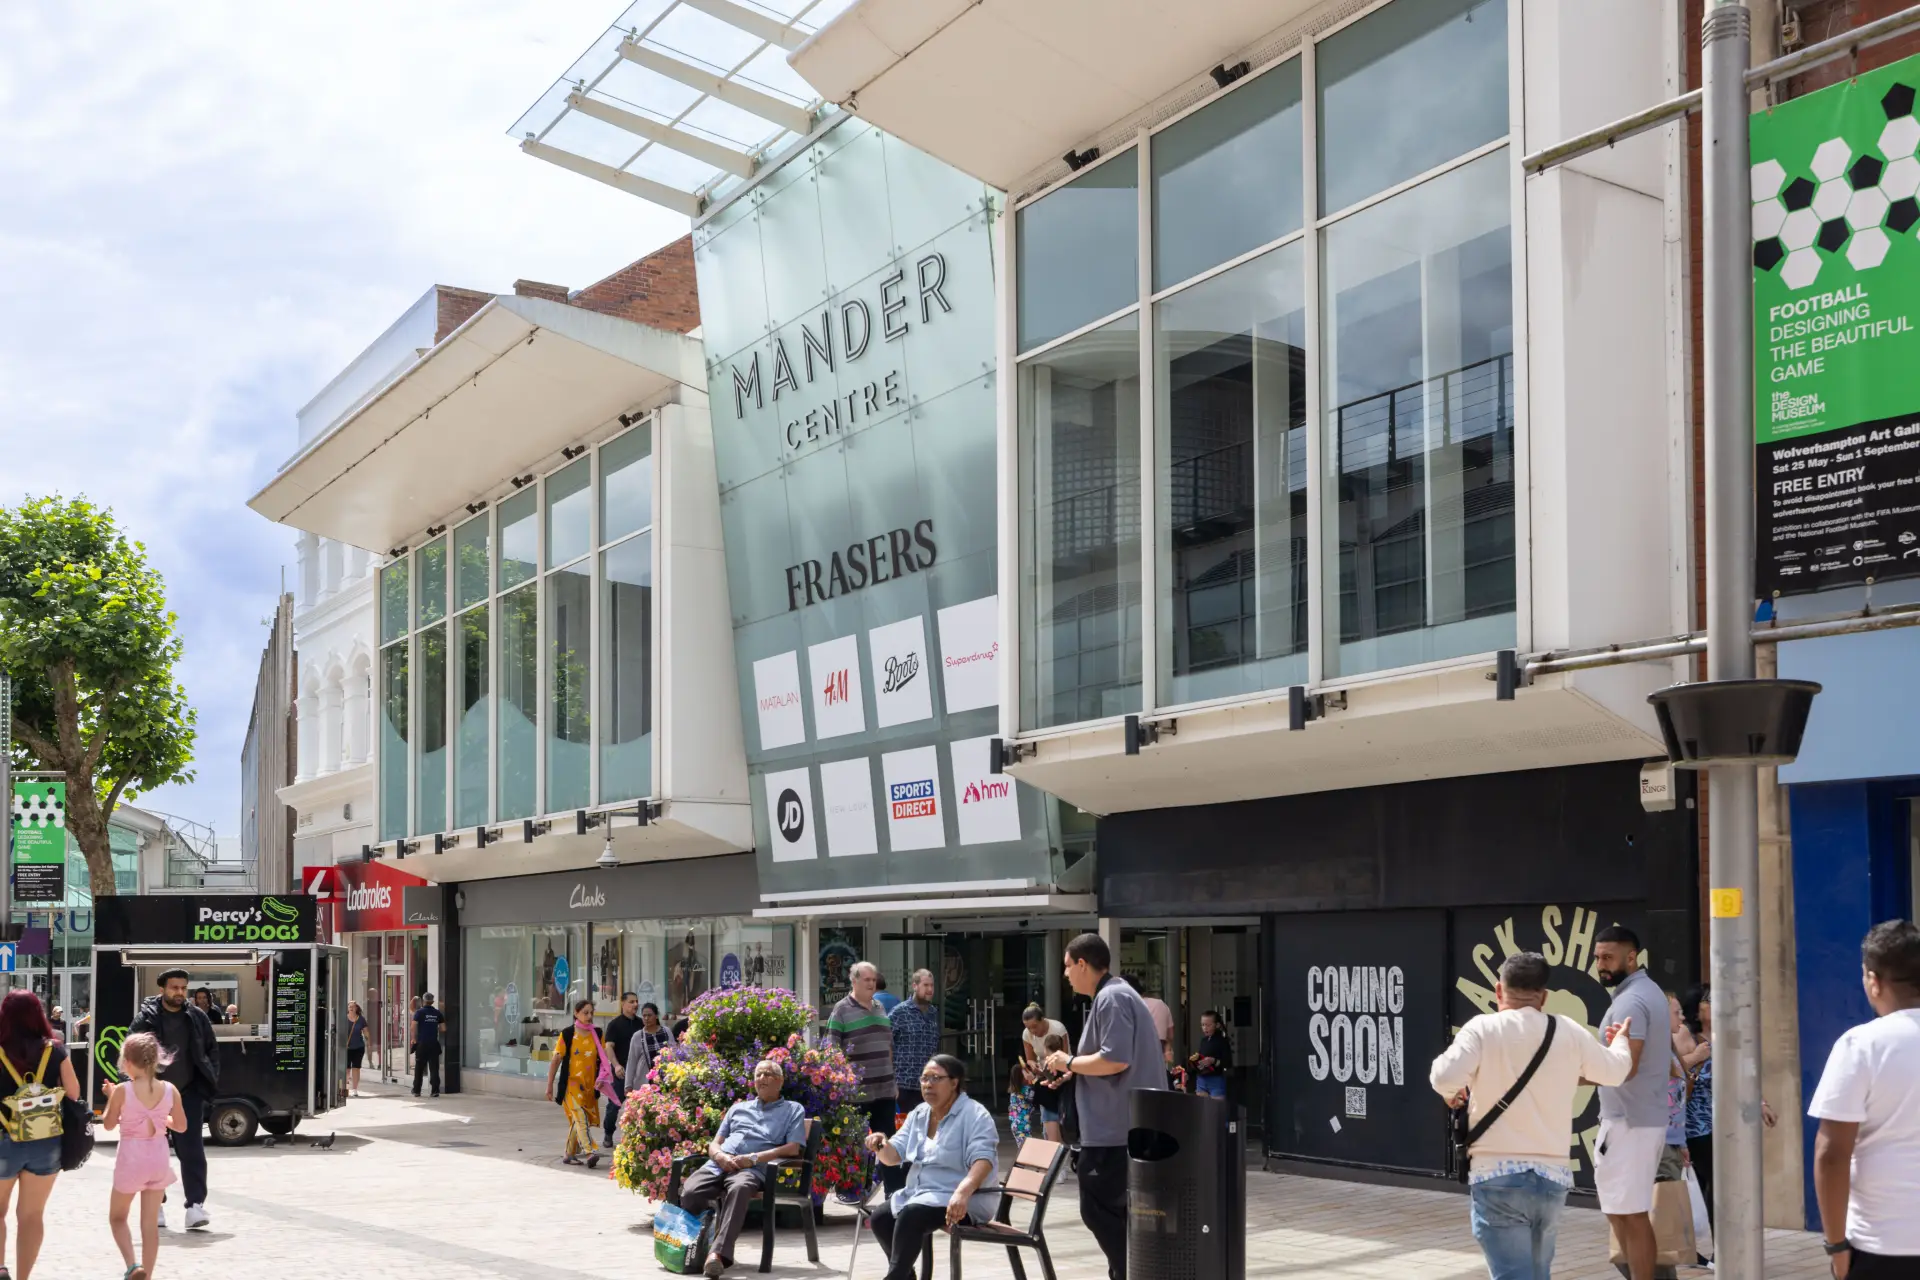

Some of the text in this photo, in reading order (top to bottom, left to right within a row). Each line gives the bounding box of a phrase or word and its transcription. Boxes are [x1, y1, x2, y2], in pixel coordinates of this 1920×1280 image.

[1770, 283, 1868, 322] FOOTBALL
[732, 251, 952, 419] MANDER
[1771, 303, 1870, 342] DESIGNING
[1770, 316, 1913, 362] THE BEAUTIFUL
[1771, 357, 1825, 382] GAME
[786, 370, 899, 450] CENTRE
[1772, 391, 1790, 402] the
[1772, 393, 1818, 412] DESIGN
[1772, 402, 1825, 422] MUSEUM
[1773, 422, 1920, 461] Wolverhampton Art Gall
[1773, 464, 1789, 474] Sat
[1792, 460, 1805, 471] 25
[1808, 457, 1828, 468] May
[1836, 451, 1854, 462] Sun
[1856, 450, 1862, 459] 1
[1864, 440, 1920, 456] September
[1773, 466, 1866, 496] FREE ENTRY
[1773, 499, 1781, 507] To
[1783, 496, 1803, 505] avoid
[1858, 483, 1876, 492] book
[1877, 480, 1896, 490] your
[1897, 478, 1913, 486] free
[1773, 498, 1863, 518] wolverhamptonart.org.uk
[785, 519, 937, 612] FRASERS
[883, 651, 919, 694] Boots
[946, 651, 994, 667] Superdrug
[760, 692, 799, 711] MATALAN
[824, 669, 849, 707] H&M
[894, 781, 931, 800] SPORTS
[981, 780, 1009, 800] hmv
[782, 800, 801, 831] JD
[895, 800, 933, 818] DIRECT
[347, 881, 391, 911] Ladbrokes
[569, 883, 606, 909] Clarks
[199, 907, 262, 924] Percy's
[409, 912, 439, 922] Clarks
[194, 925, 299, 940] HOT-DOGS
[1307, 965, 1404, 1013] COMING
[1308, 1013, 1404, 1086] SOON
